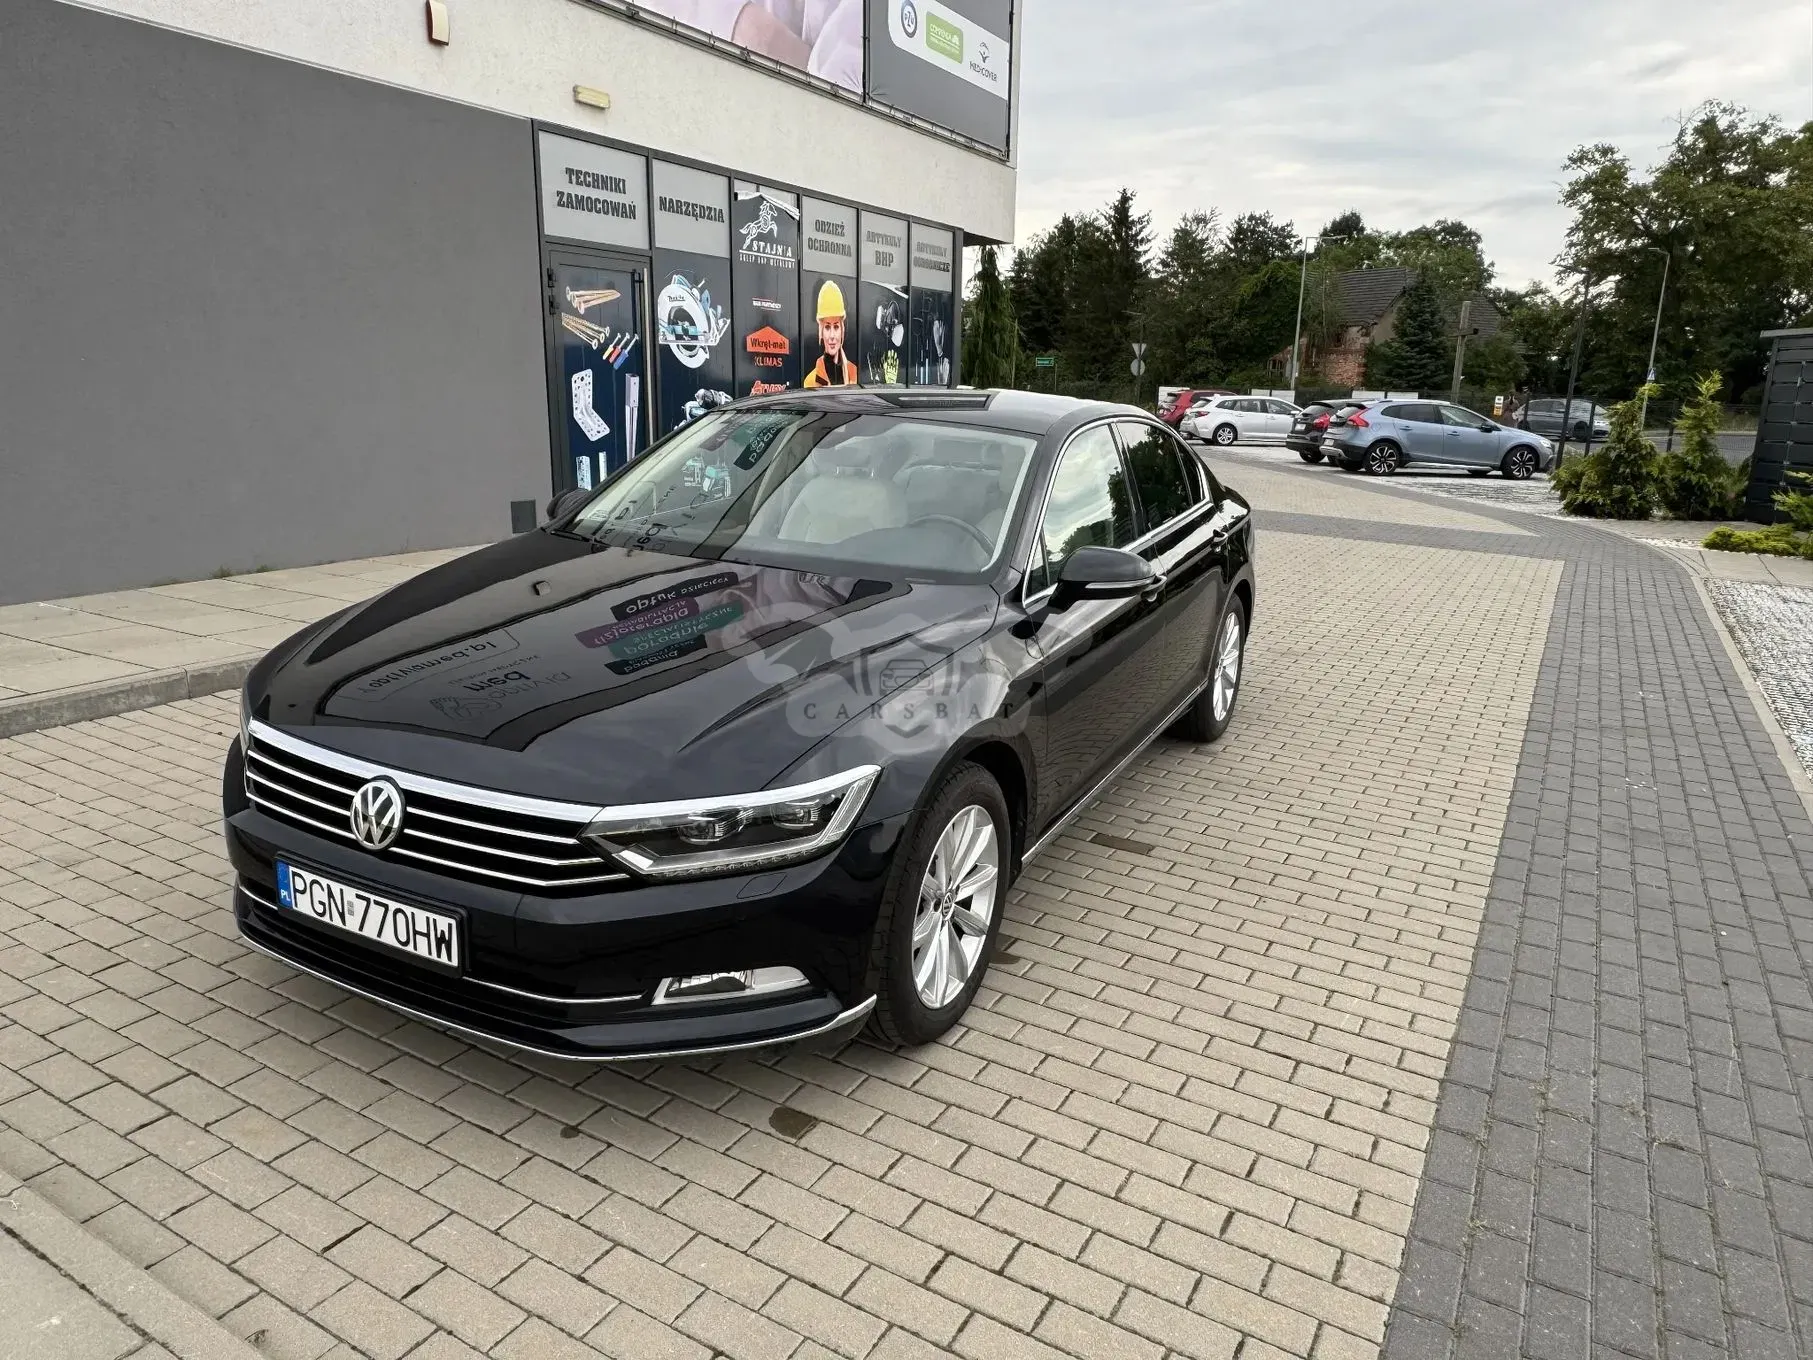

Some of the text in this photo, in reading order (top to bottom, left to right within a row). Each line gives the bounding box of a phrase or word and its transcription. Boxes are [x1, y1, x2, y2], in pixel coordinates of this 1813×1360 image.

[969, 61, 998, 82] MEDICOVER
[565, 167, 627, 195] TECHNIKI
[556, 191, 637, 220] ZAMOCOWAŃ
[658, 196, 725, 223] NARZĘDZIA
[814, 219, 846, 238] ODZIEŻ
[751, 240, 792, 257] STAJNIA
[807, 237, 852, 258] OCHRONNA
[875, 250, 894, 268] BHP
[754, 356, 783, 368] KLIMAS
[280, 889, 292, 902] PL
[290, 869, 454, 963] PGN 770HW
